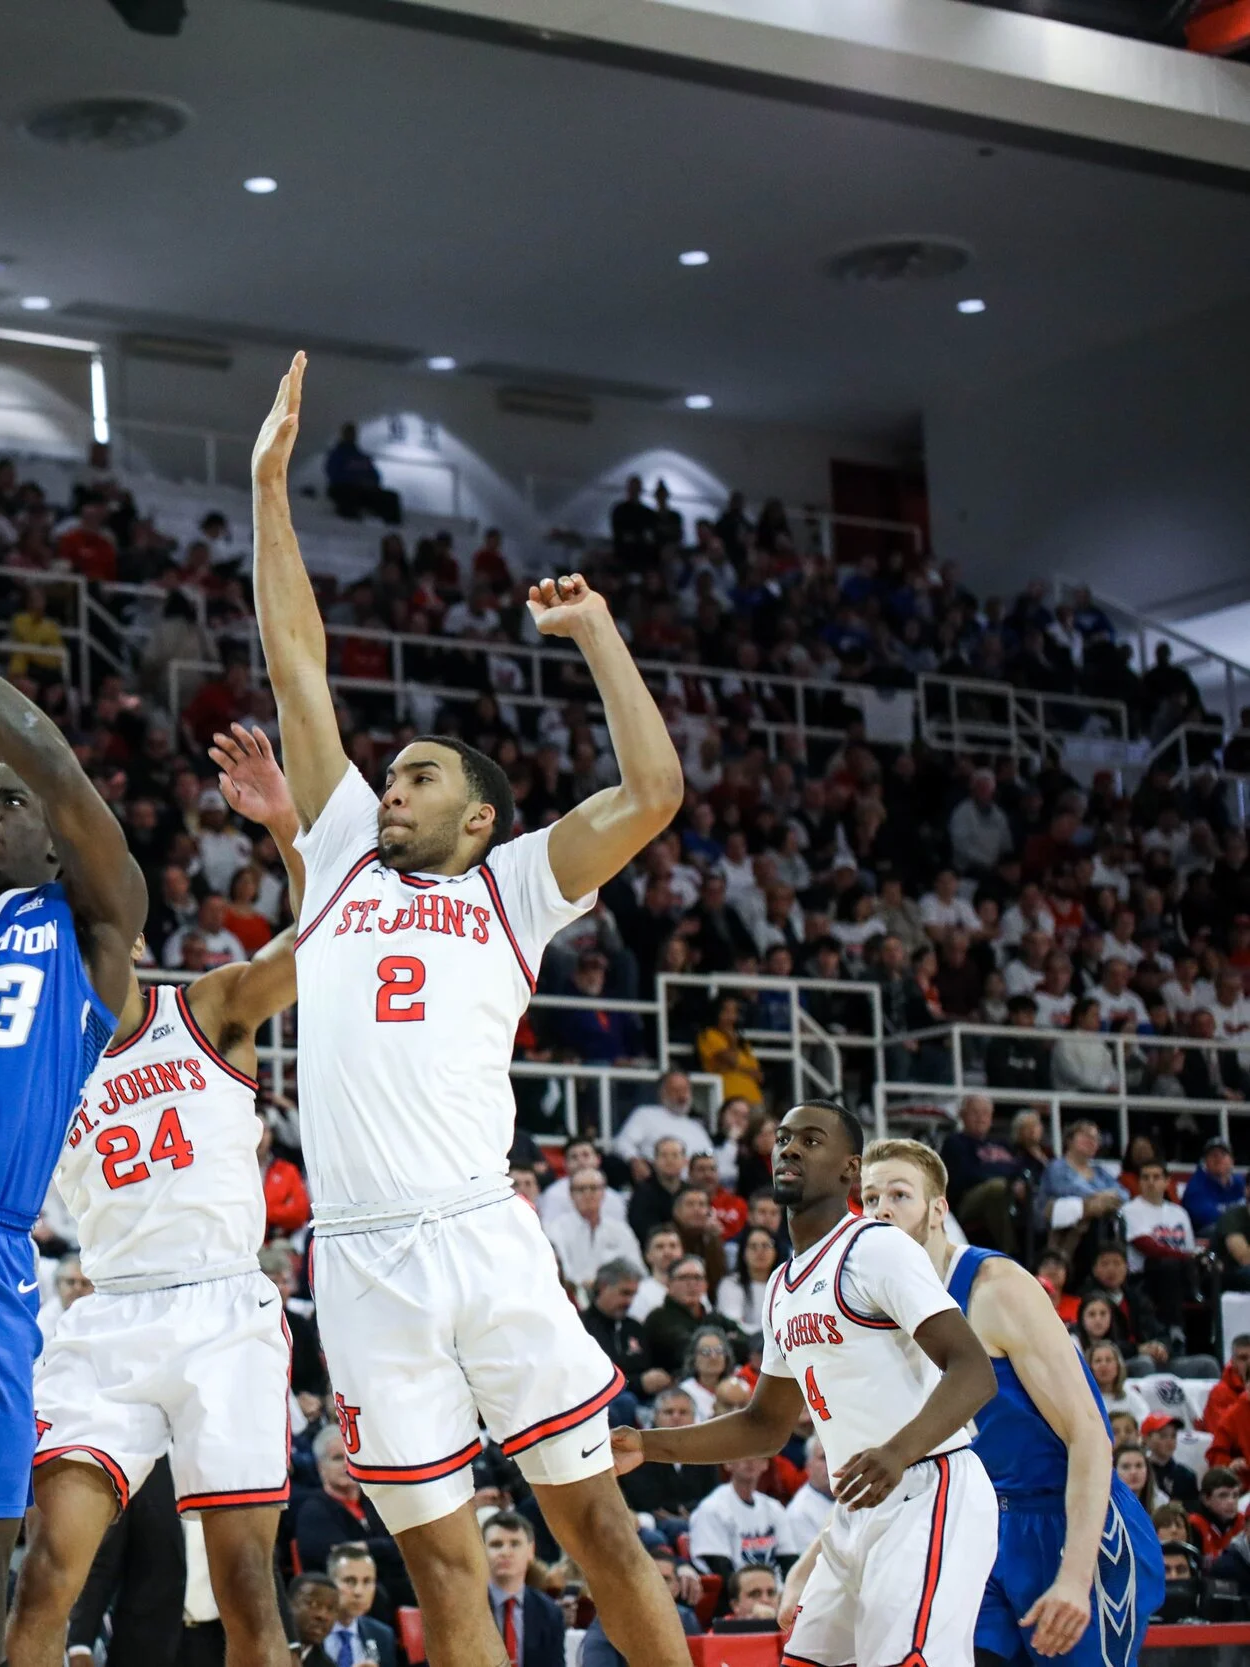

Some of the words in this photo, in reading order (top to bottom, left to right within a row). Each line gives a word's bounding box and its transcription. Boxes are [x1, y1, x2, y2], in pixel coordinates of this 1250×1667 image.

[333, 898, 382, 937] ST.
[376, 955, 426, 1022] 2
[98, 1058, 207, 1115] JOHN'S
[95, 1107, 194, 1190] 24
[784, 1312, 844, 1352] JOHN'S
[805, 1365, 832, 1422] 4
